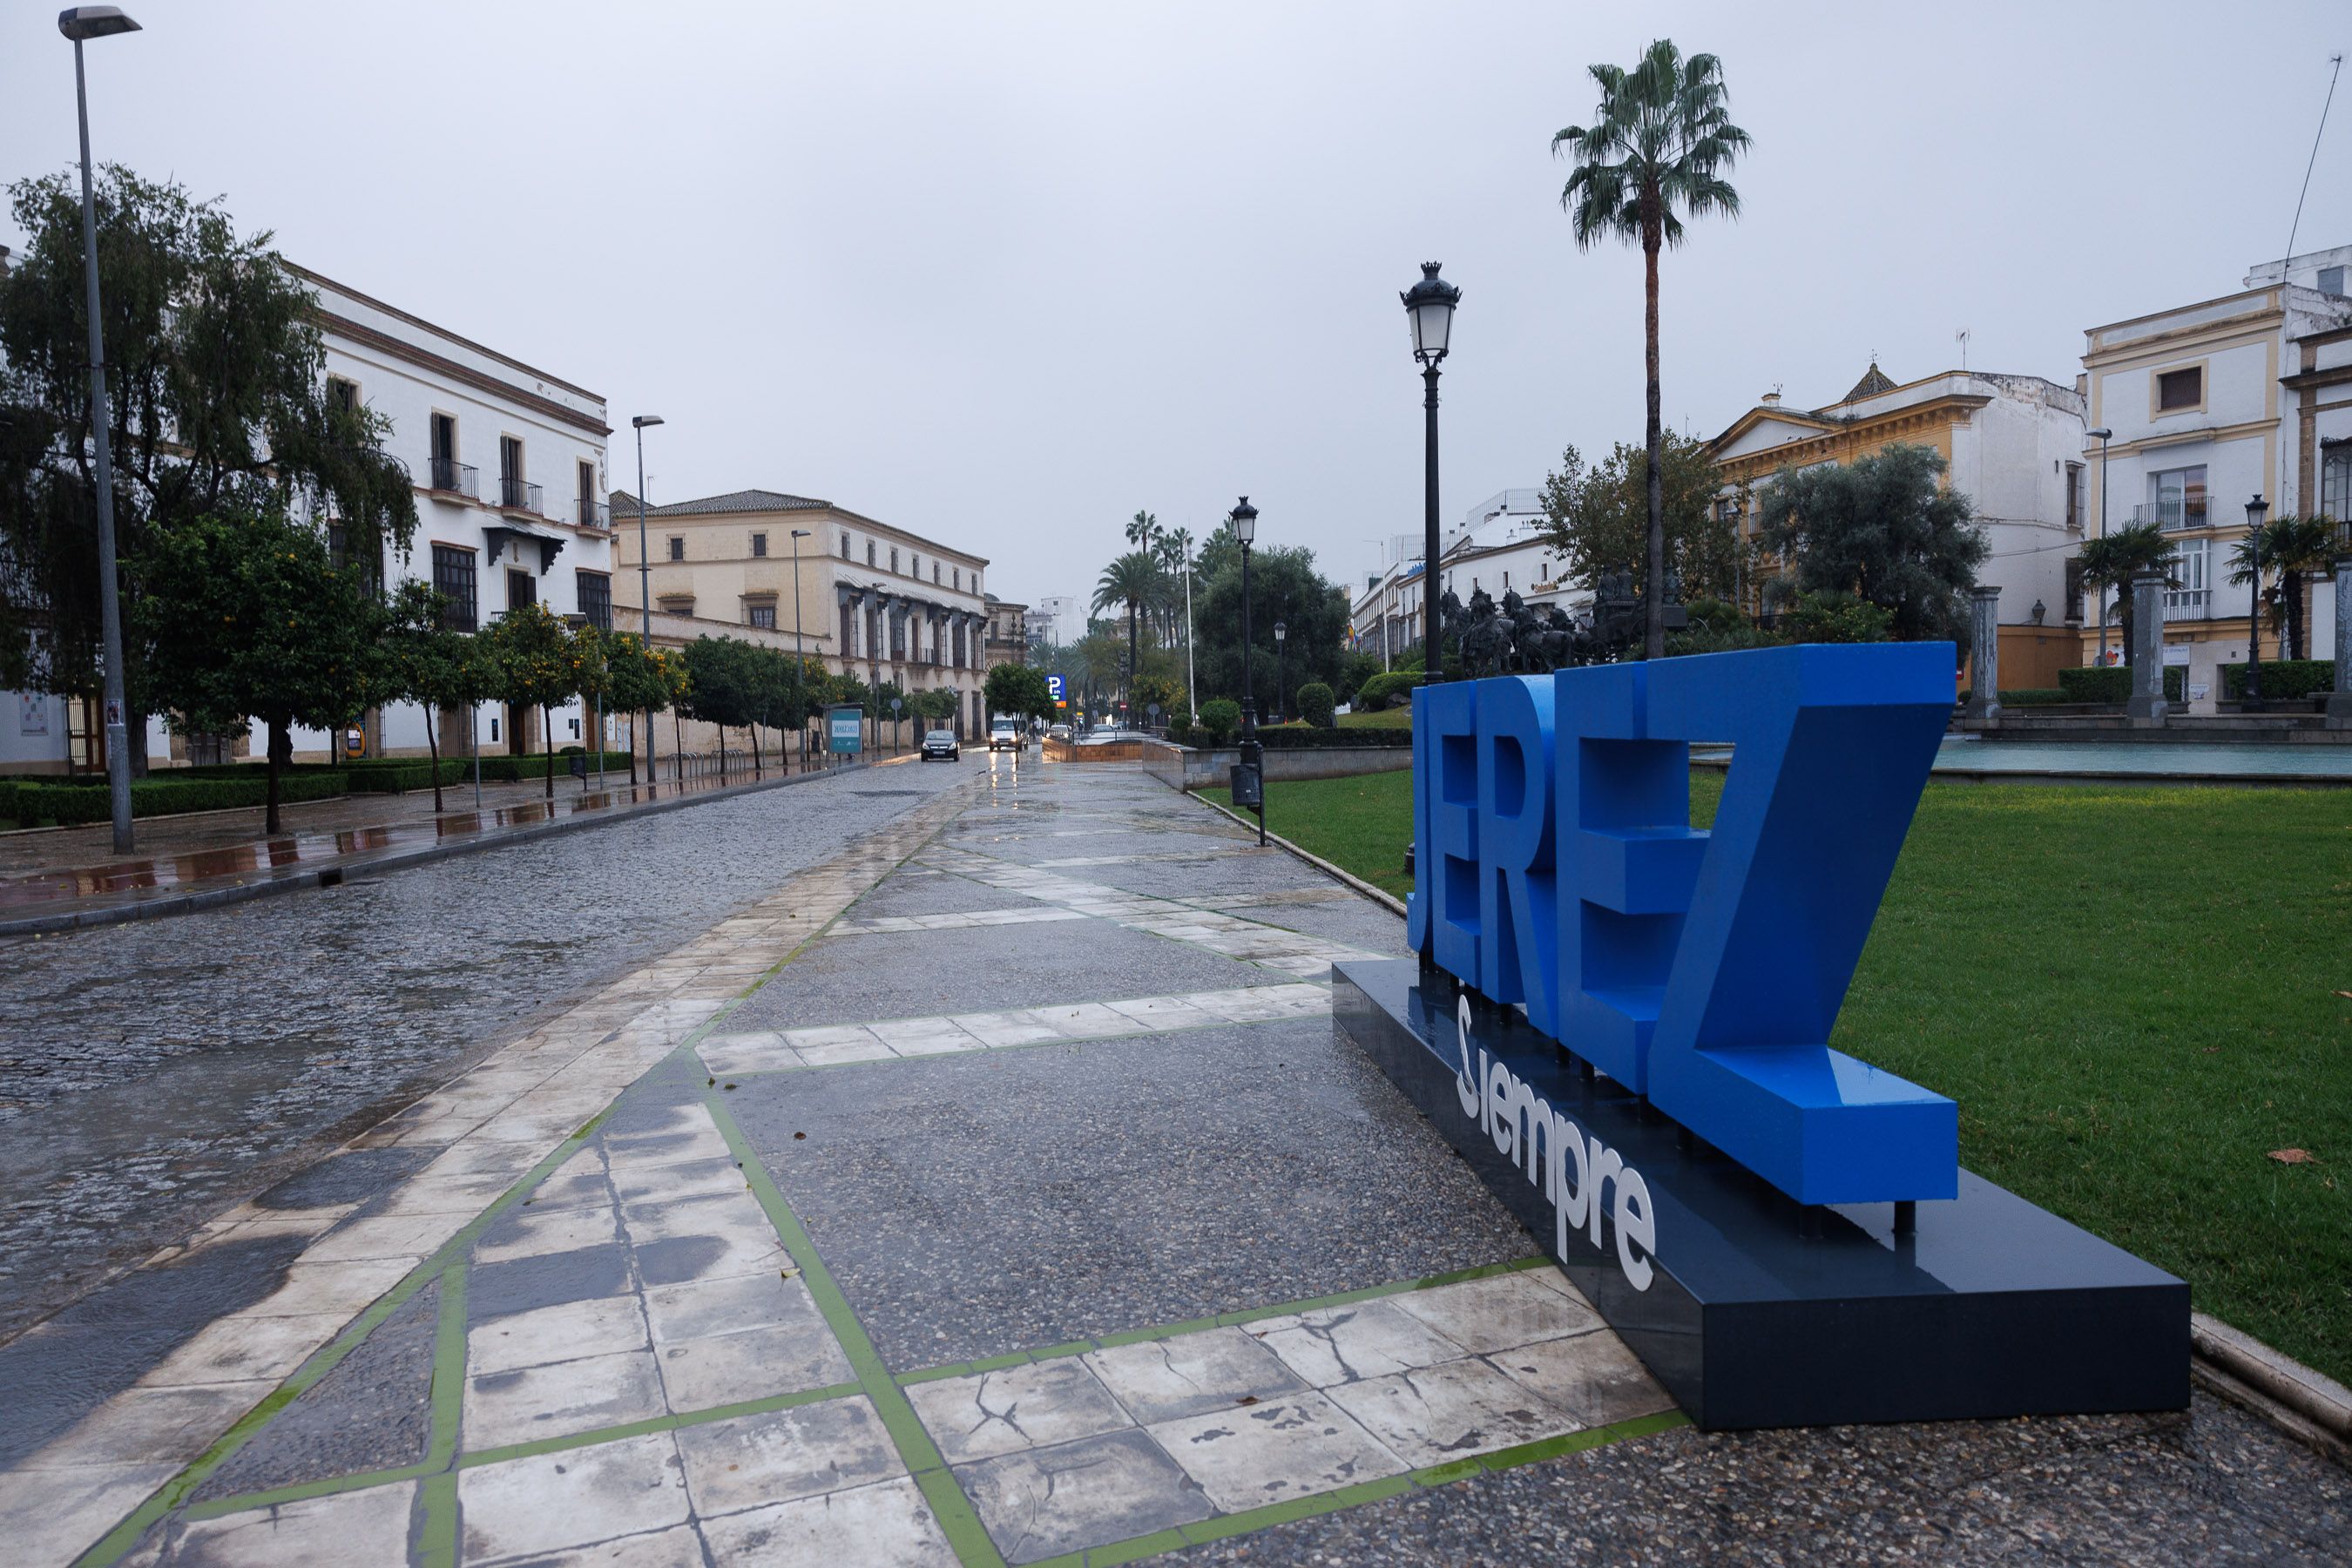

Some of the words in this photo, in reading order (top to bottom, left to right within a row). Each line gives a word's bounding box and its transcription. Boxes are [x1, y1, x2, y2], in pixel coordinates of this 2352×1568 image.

[1048, 677, 1061, 694] P
[1407, 641, 1957, 1204] JEREZ
[1456, 994, 1655, 1292] Siempre
